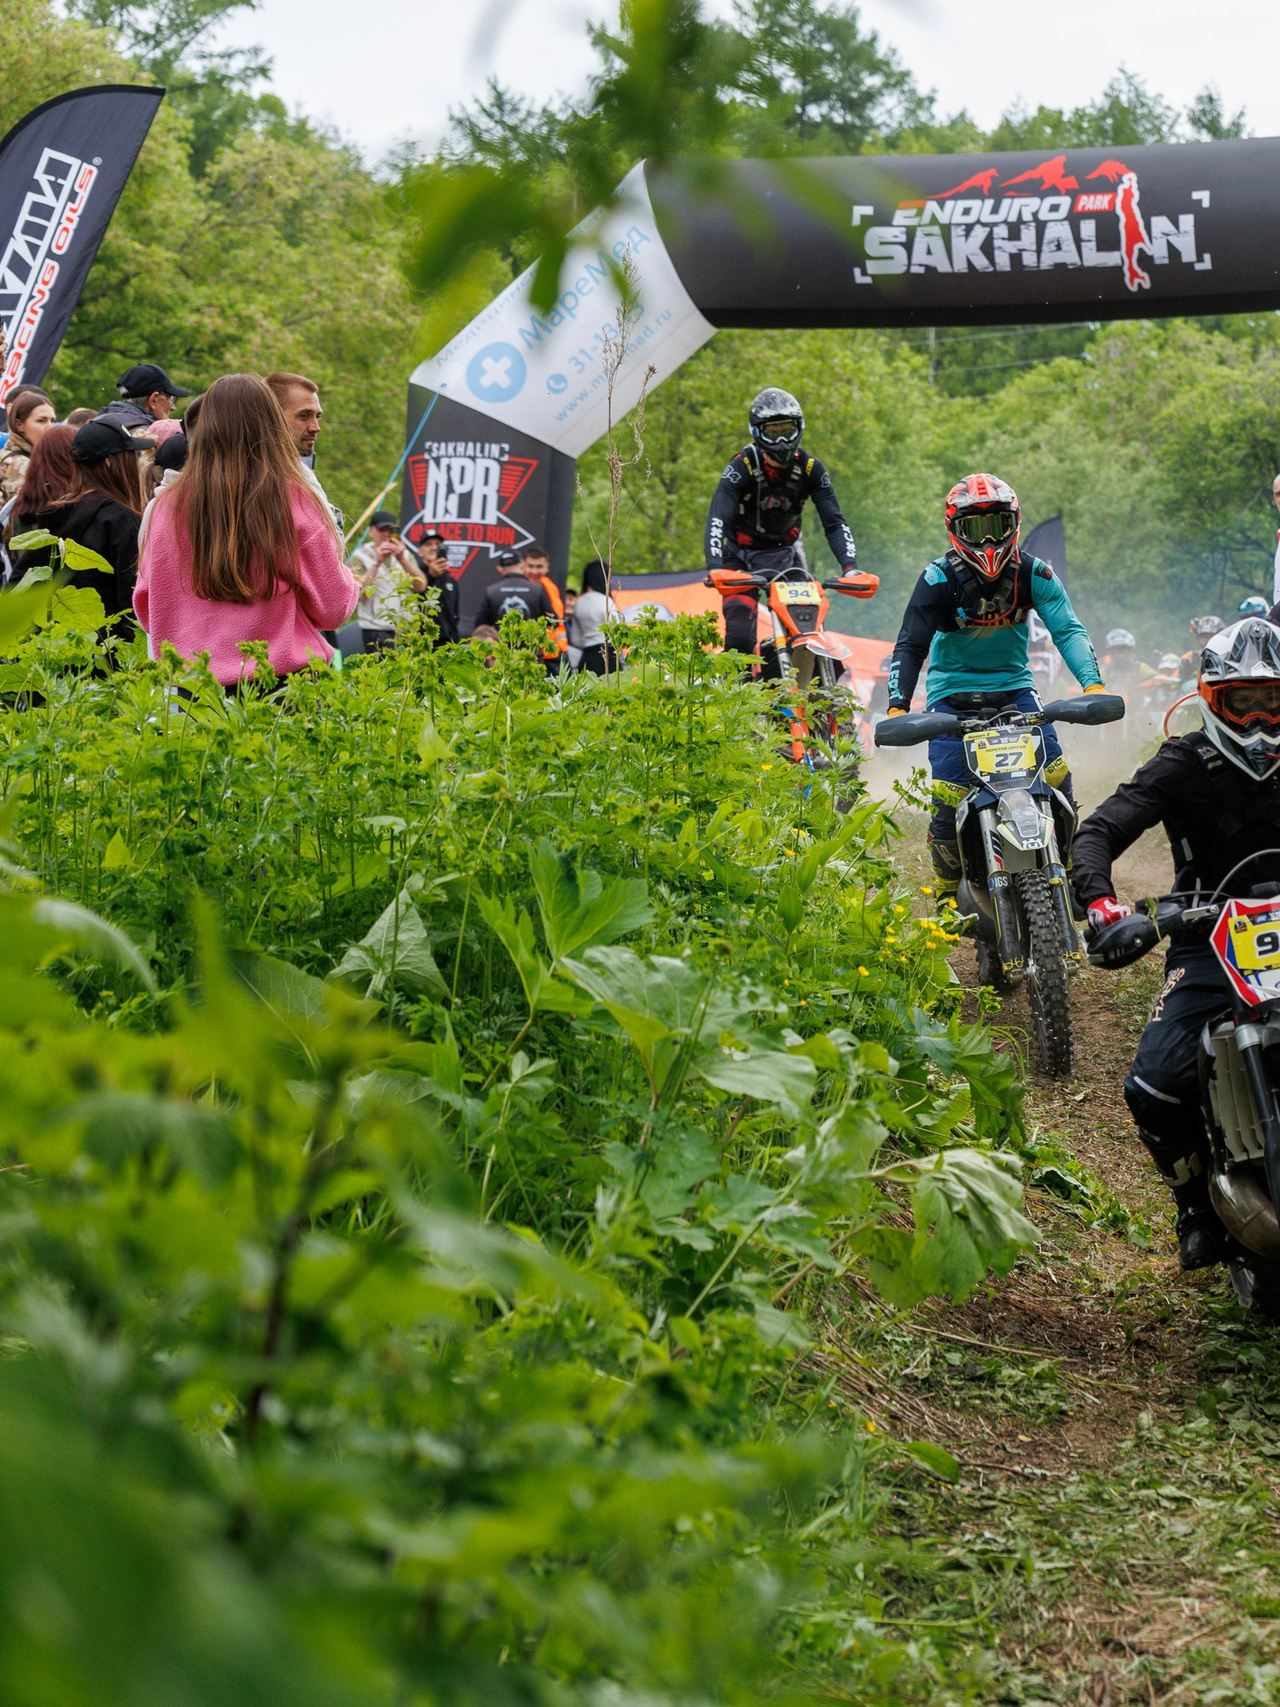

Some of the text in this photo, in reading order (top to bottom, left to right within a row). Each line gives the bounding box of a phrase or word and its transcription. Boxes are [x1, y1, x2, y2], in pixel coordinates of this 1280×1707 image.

[54, 166, 97, 252] OILS
[892, 194, 1113, 226] ENDURO PARK
[518, 225, 652, 350] МареМед
[431, 441, 501, 459] SAKHALIN
[423, 456, 501, 525] NPR
[466, 526, 484, 543] TO
[486, 527, 516, 545] RUN
[788, 589, 811, 598] 94
[994, 751, 1024, 769] 27
